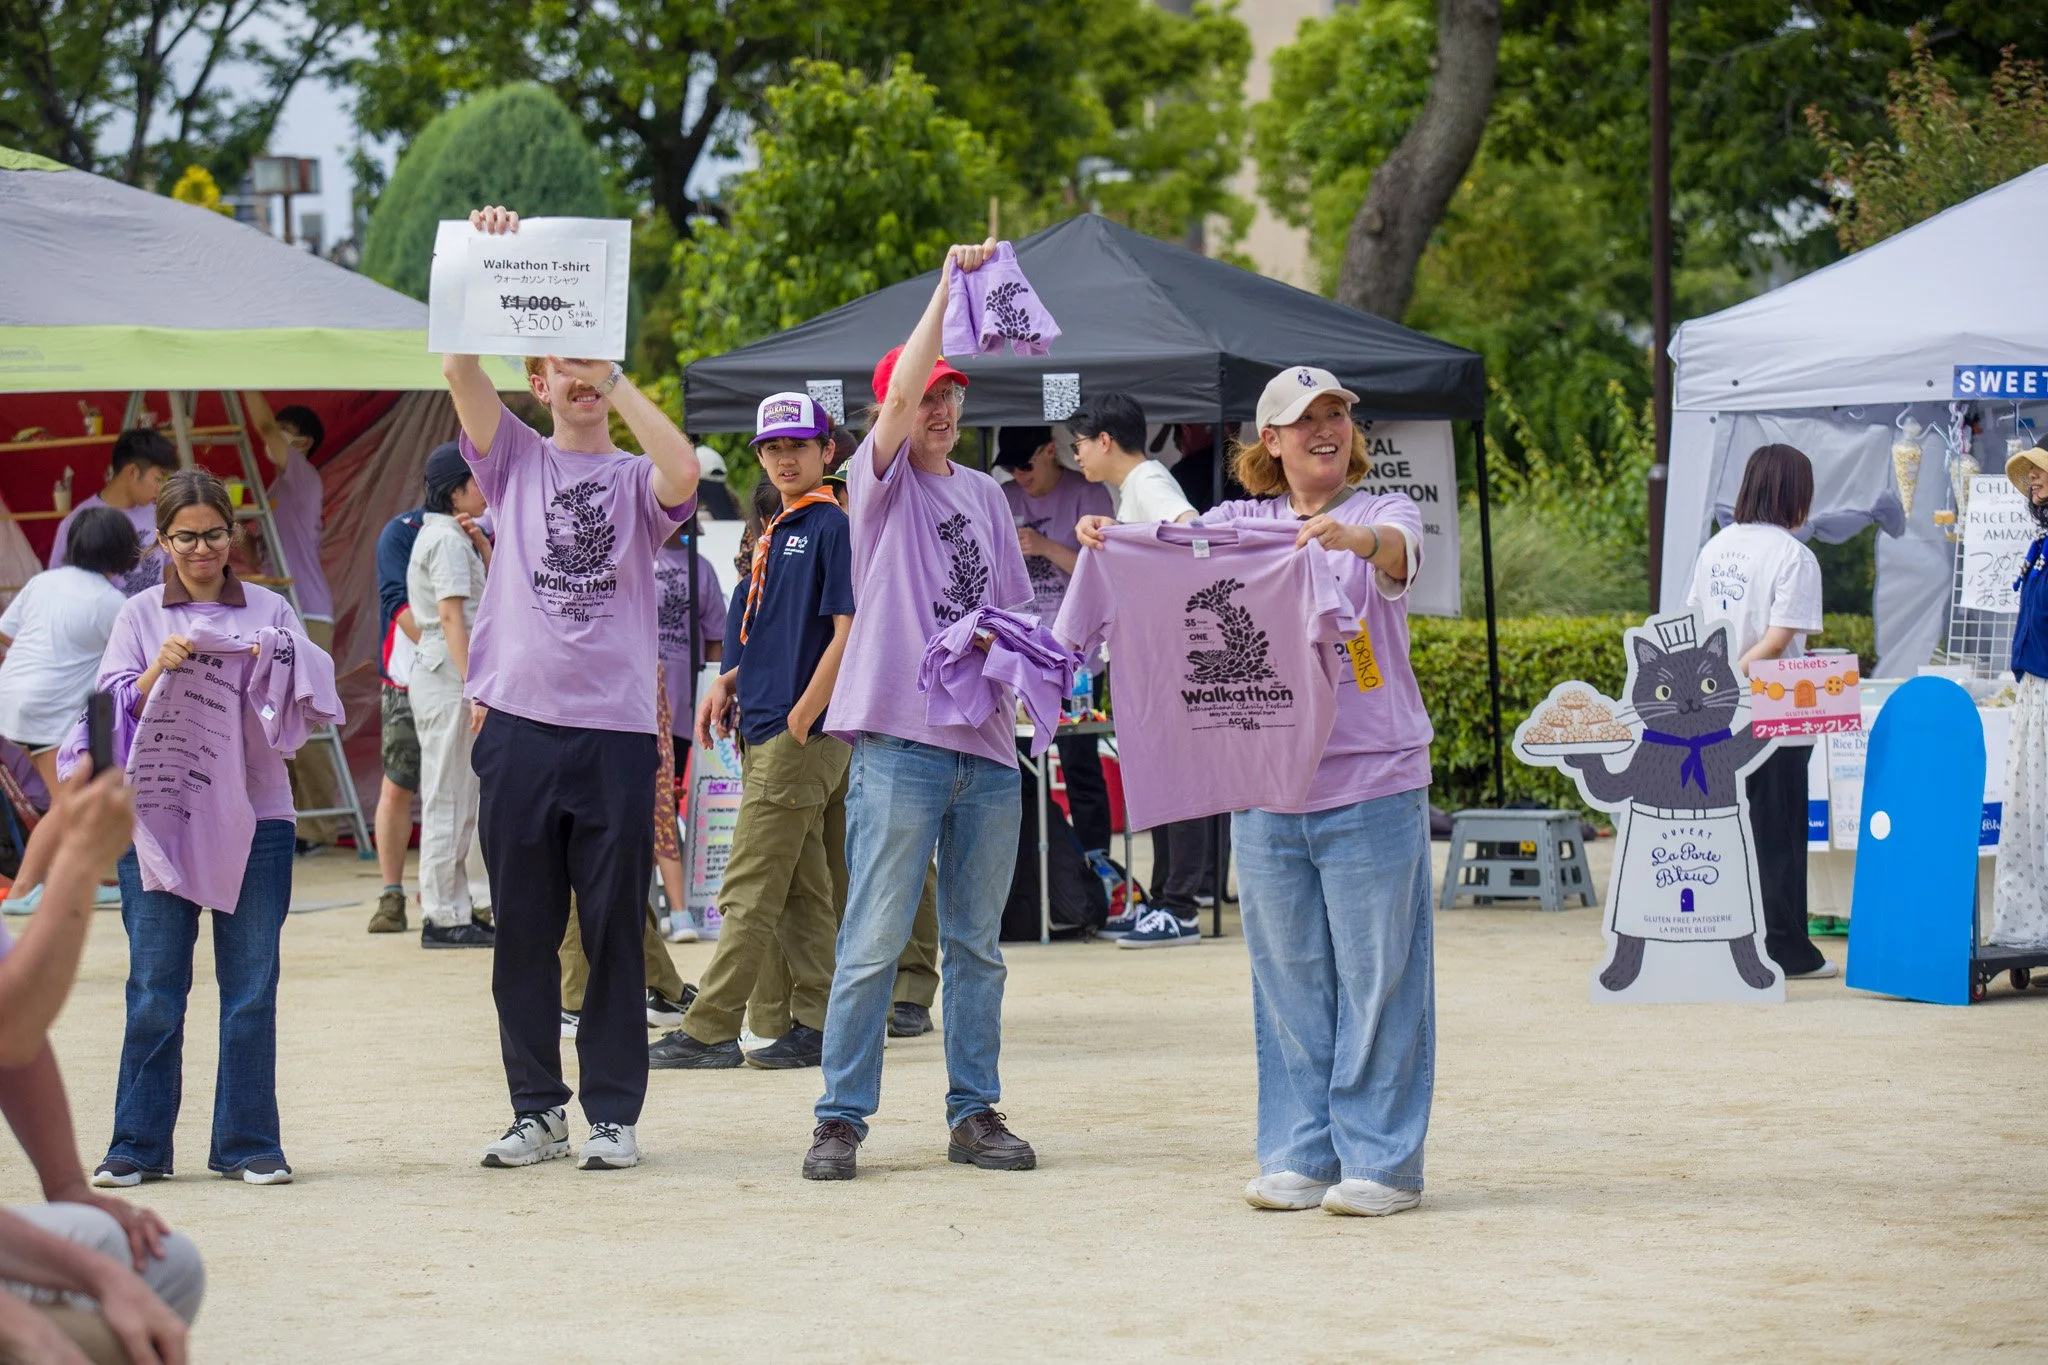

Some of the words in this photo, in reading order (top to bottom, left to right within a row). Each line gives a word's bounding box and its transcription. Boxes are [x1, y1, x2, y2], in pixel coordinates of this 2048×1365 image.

[484, 259, 548, 271] Walkathon
[552, 261, 590, 272] T-shirt
[494, 275, 545, 284] ウォーカソン
[510, 313, 563, 334] ¥500
[534, 571, 616, 593] Walkathon
[561, 607, 585, 616] ACCJ
[574, 614, 590, 622] NIS
[1184, 618, 1197, 627] 35
[1189, 633, 1208, 641] ONE
[1779, 662, 1785, 671] 5
[1789, 659, 1828, 671] tickets
[1181, 686, 1293, 704] Walkathon
[1187, 703, 1234, 712] International
[1237, 702, 1263, 711] Charity
[1266, 701, 1293, 709] Festival
[1228, 717, 1254, 725] ACCJ
[1755, 719, 1861, 738] クッキーネックレス
[1662, 827, 1712, 840] OUVERT
[1652, 847, 1679, 867] La
[1681, 842, 1721, 862] Porte
[1656, 865, 1719, 888] Bleue
[1643, 915, 1671, 923] GLUTEN
[1692, 914, 1732, 923] PATISSERIE
[1670, 926, 1692, 934] PORTE
